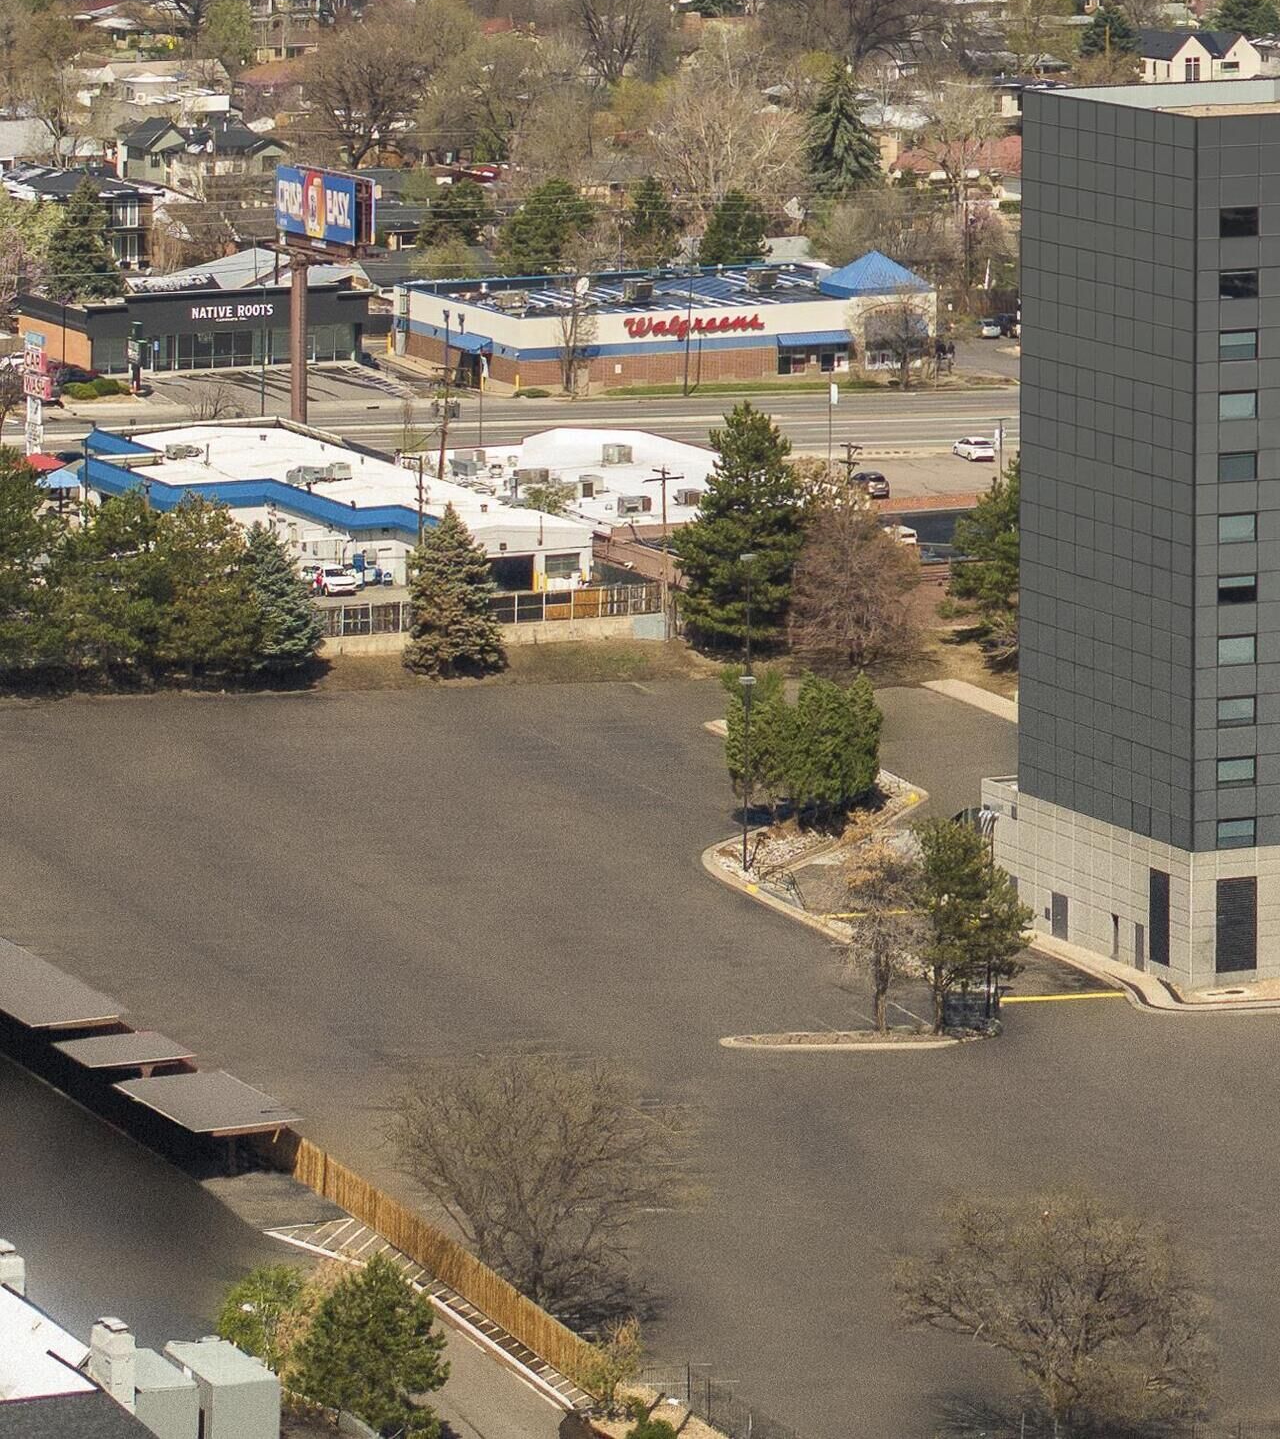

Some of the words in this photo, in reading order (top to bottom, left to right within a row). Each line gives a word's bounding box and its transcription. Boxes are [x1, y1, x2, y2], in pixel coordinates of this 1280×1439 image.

[192, 306, 234, 320] NATIVE
[237, 303, 274, 317] ROOTS
[623, 313, 766, 342] Walgreens
